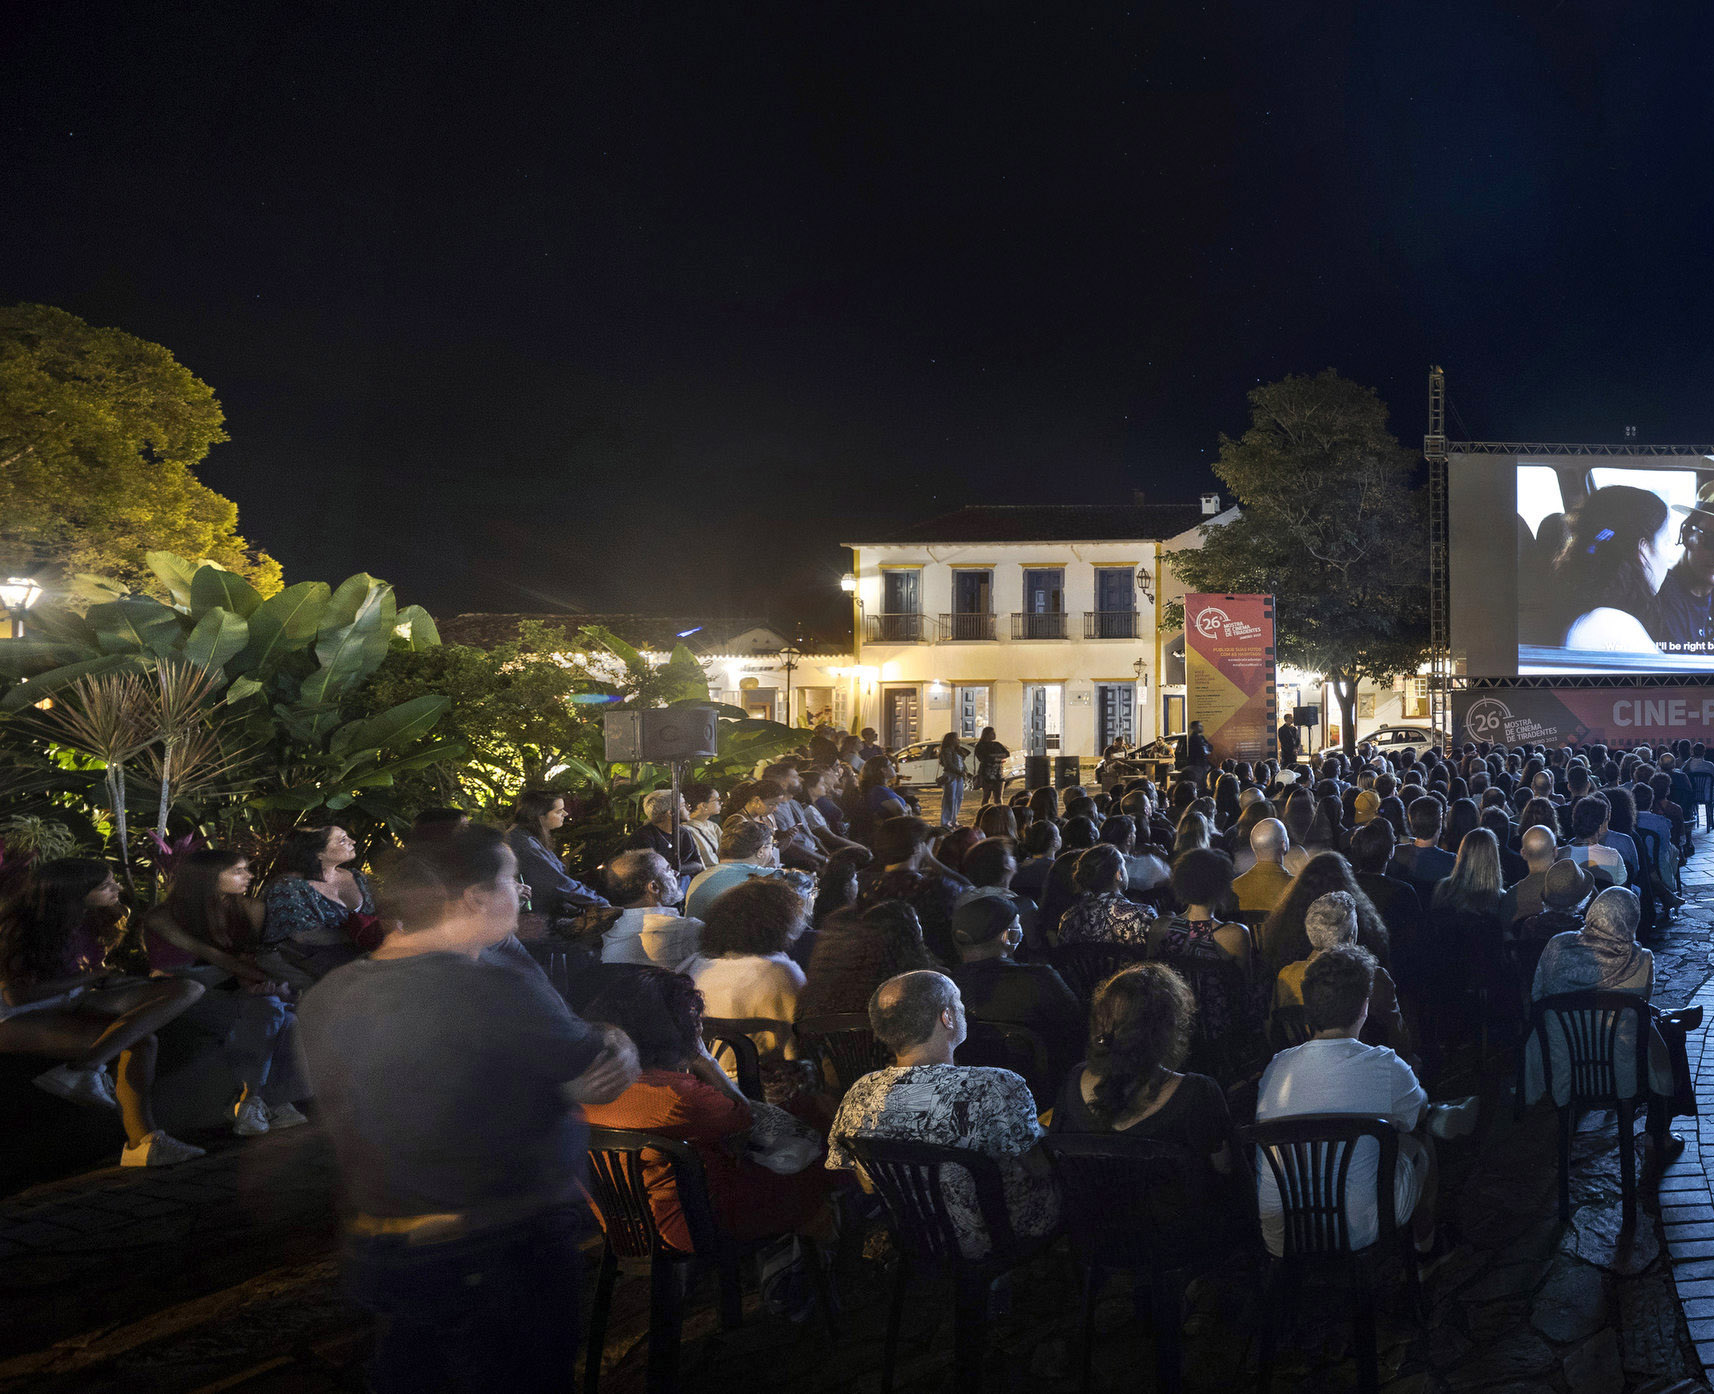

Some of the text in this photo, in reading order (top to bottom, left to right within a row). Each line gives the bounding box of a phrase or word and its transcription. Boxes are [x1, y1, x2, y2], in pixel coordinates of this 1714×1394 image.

[1655, 641, 1667, 651] I'll
[1669, 642, 1681, 651] be
[1683, 641, 1712, 652] right
[1504, 719, 1532, 729] MOSTRA
[1505, 723, 1542, 736] DE CINEMA
[1506, 727, 1558, 743] DE TIRADENTES
